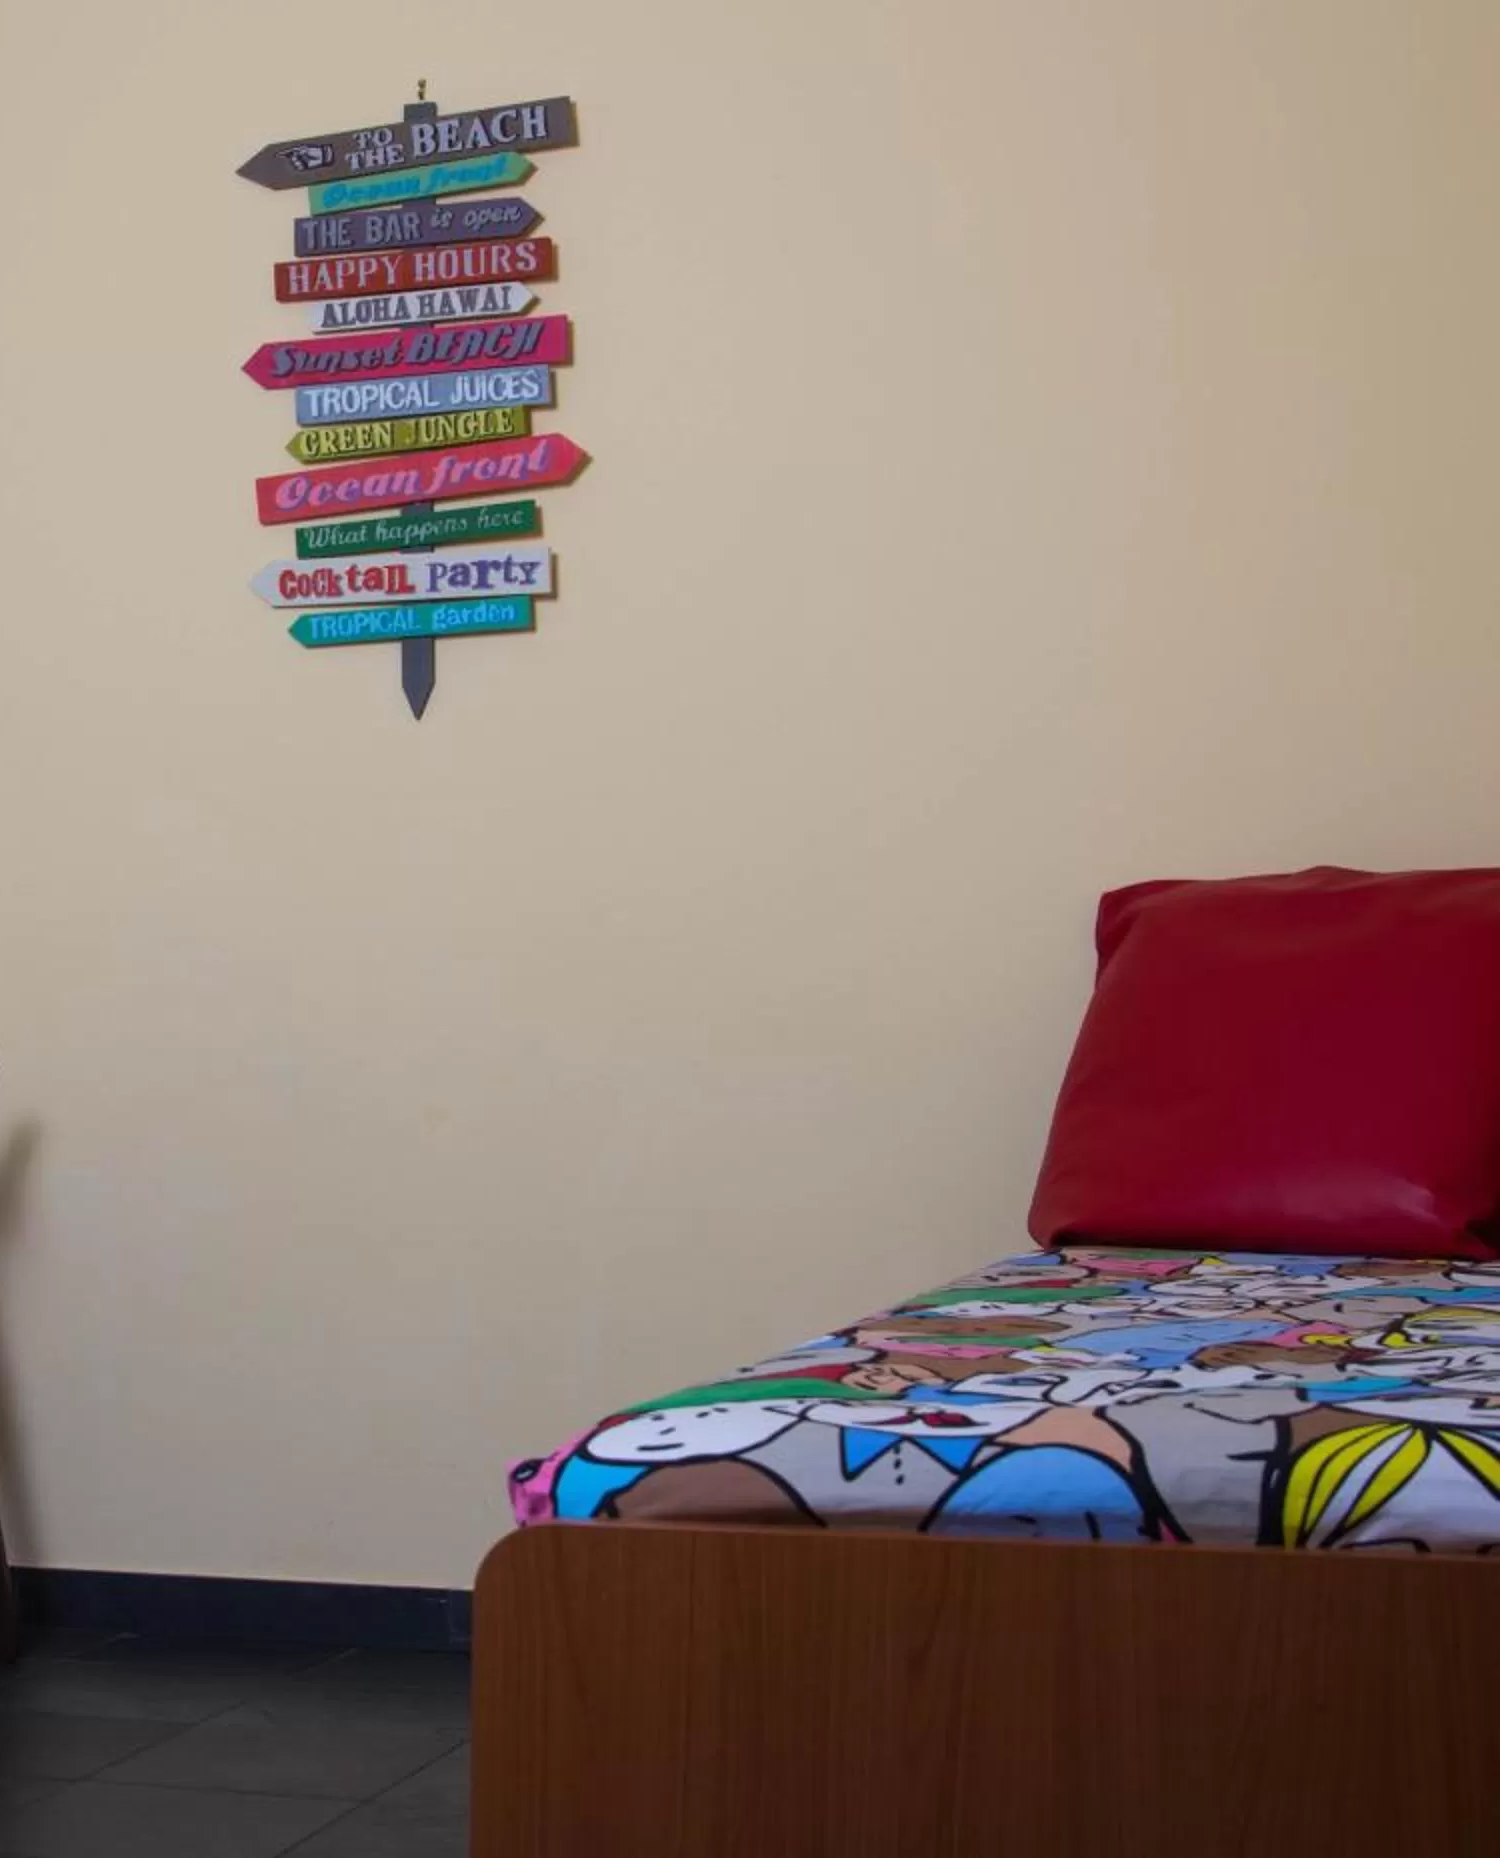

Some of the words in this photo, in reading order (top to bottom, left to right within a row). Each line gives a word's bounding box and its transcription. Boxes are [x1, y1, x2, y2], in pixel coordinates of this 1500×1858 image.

[354, 128, 394, 146] TO
[411, 105, 547, 157] BEACH
[346, 143, 404, 171] THE
[303, 219, 350, 249] THE
[364, 211, 420, 244] BAR
[431, 209, 452, 229] is
[463, 205, 521, 231] open
[288, 256, 404, 294] HAPPY
[414, 243, 536, 282] HOURS
[322, 299, 411, 328] ALOHA
[416, 285, 511, 318] HAWAI
[270, 340, 404, 377] Sunset
[304, 382, 440, 418] TROPICAL
[450, 368, 540, 402] JUICES
[303, 423, 397, 456] GREEN
[405, 410, 514, 444] JUNGLE
[276, 467, 418, 510] Ocean
[424, 440, 548, 495] front
[304, 528, 369, 548] What
[375, 518, 467, 545] happens
[477, 506, 525, 528] here
[311, 610, 421, 641] TROPICAL
[431, 602, 516, 630] garden
